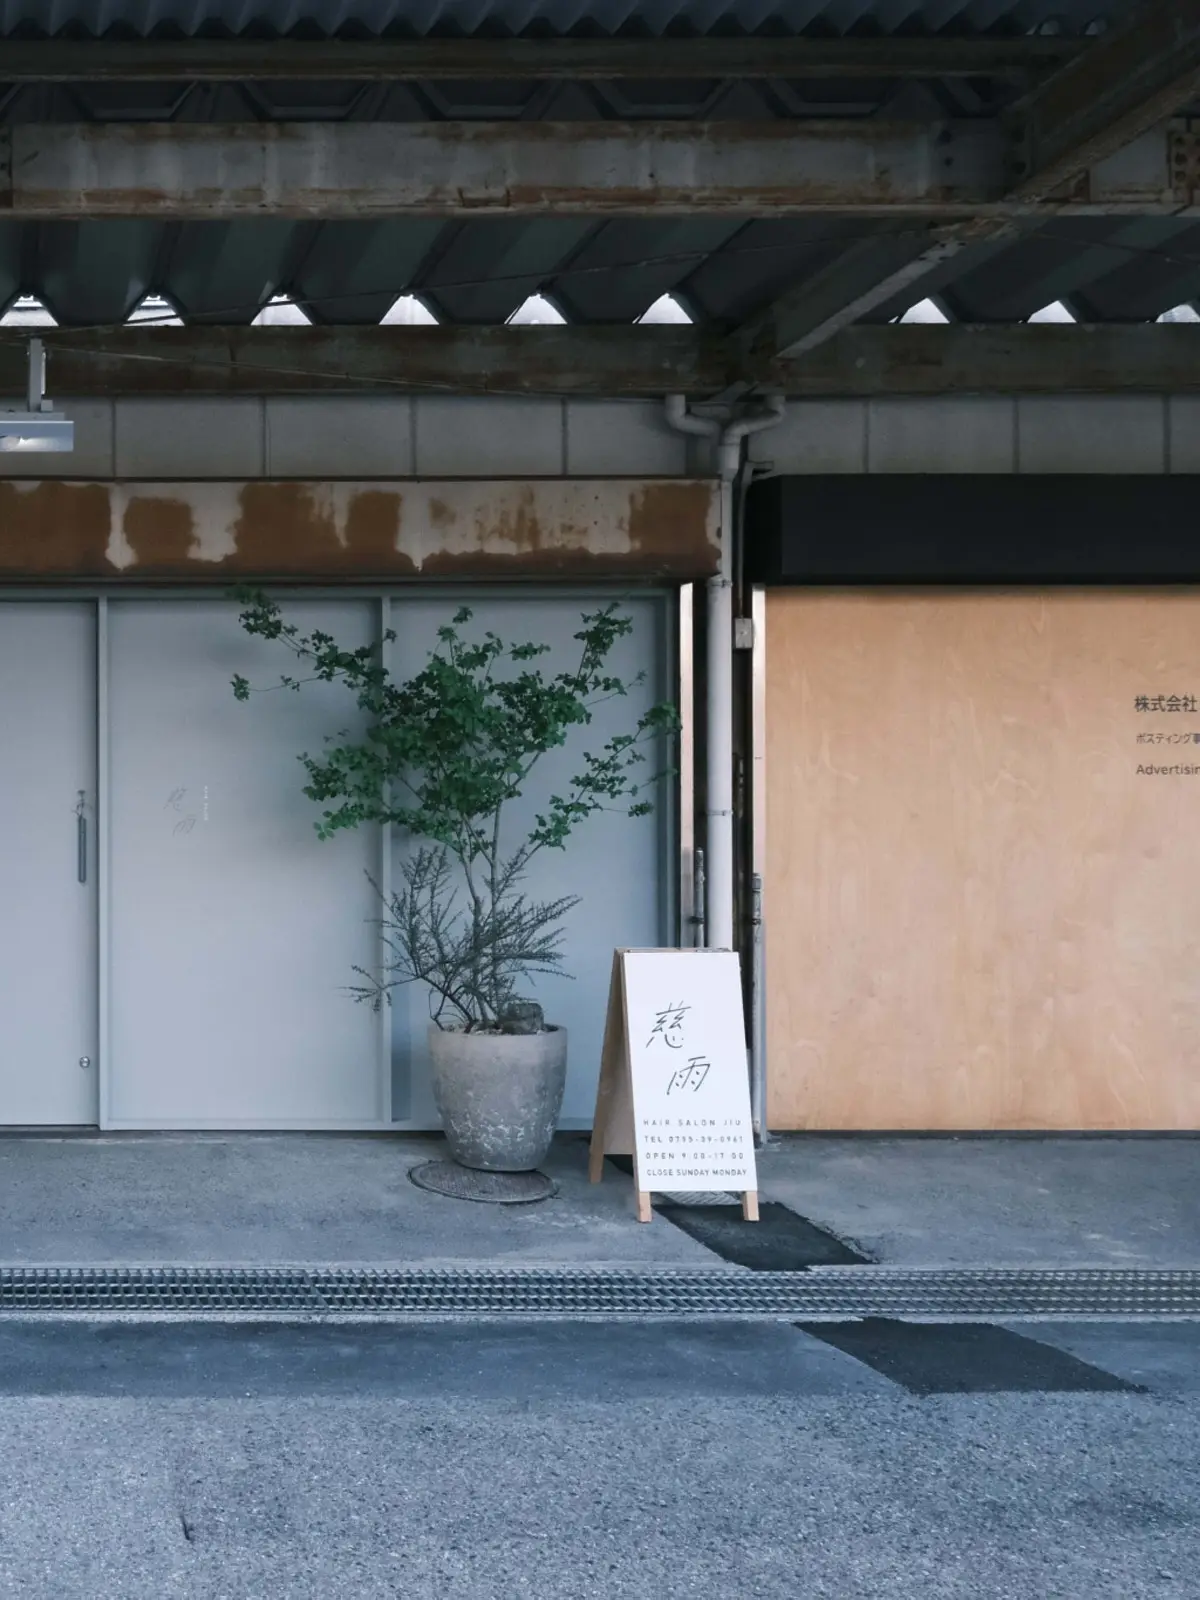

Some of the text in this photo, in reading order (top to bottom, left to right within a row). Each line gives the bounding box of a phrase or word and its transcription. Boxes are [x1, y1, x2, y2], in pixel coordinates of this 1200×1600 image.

[1134, 694, 1198, 712] 株式会社
[645, 1000, 711, 1096] 慈雨
[645, 1152, 675, 1160] OPEN
